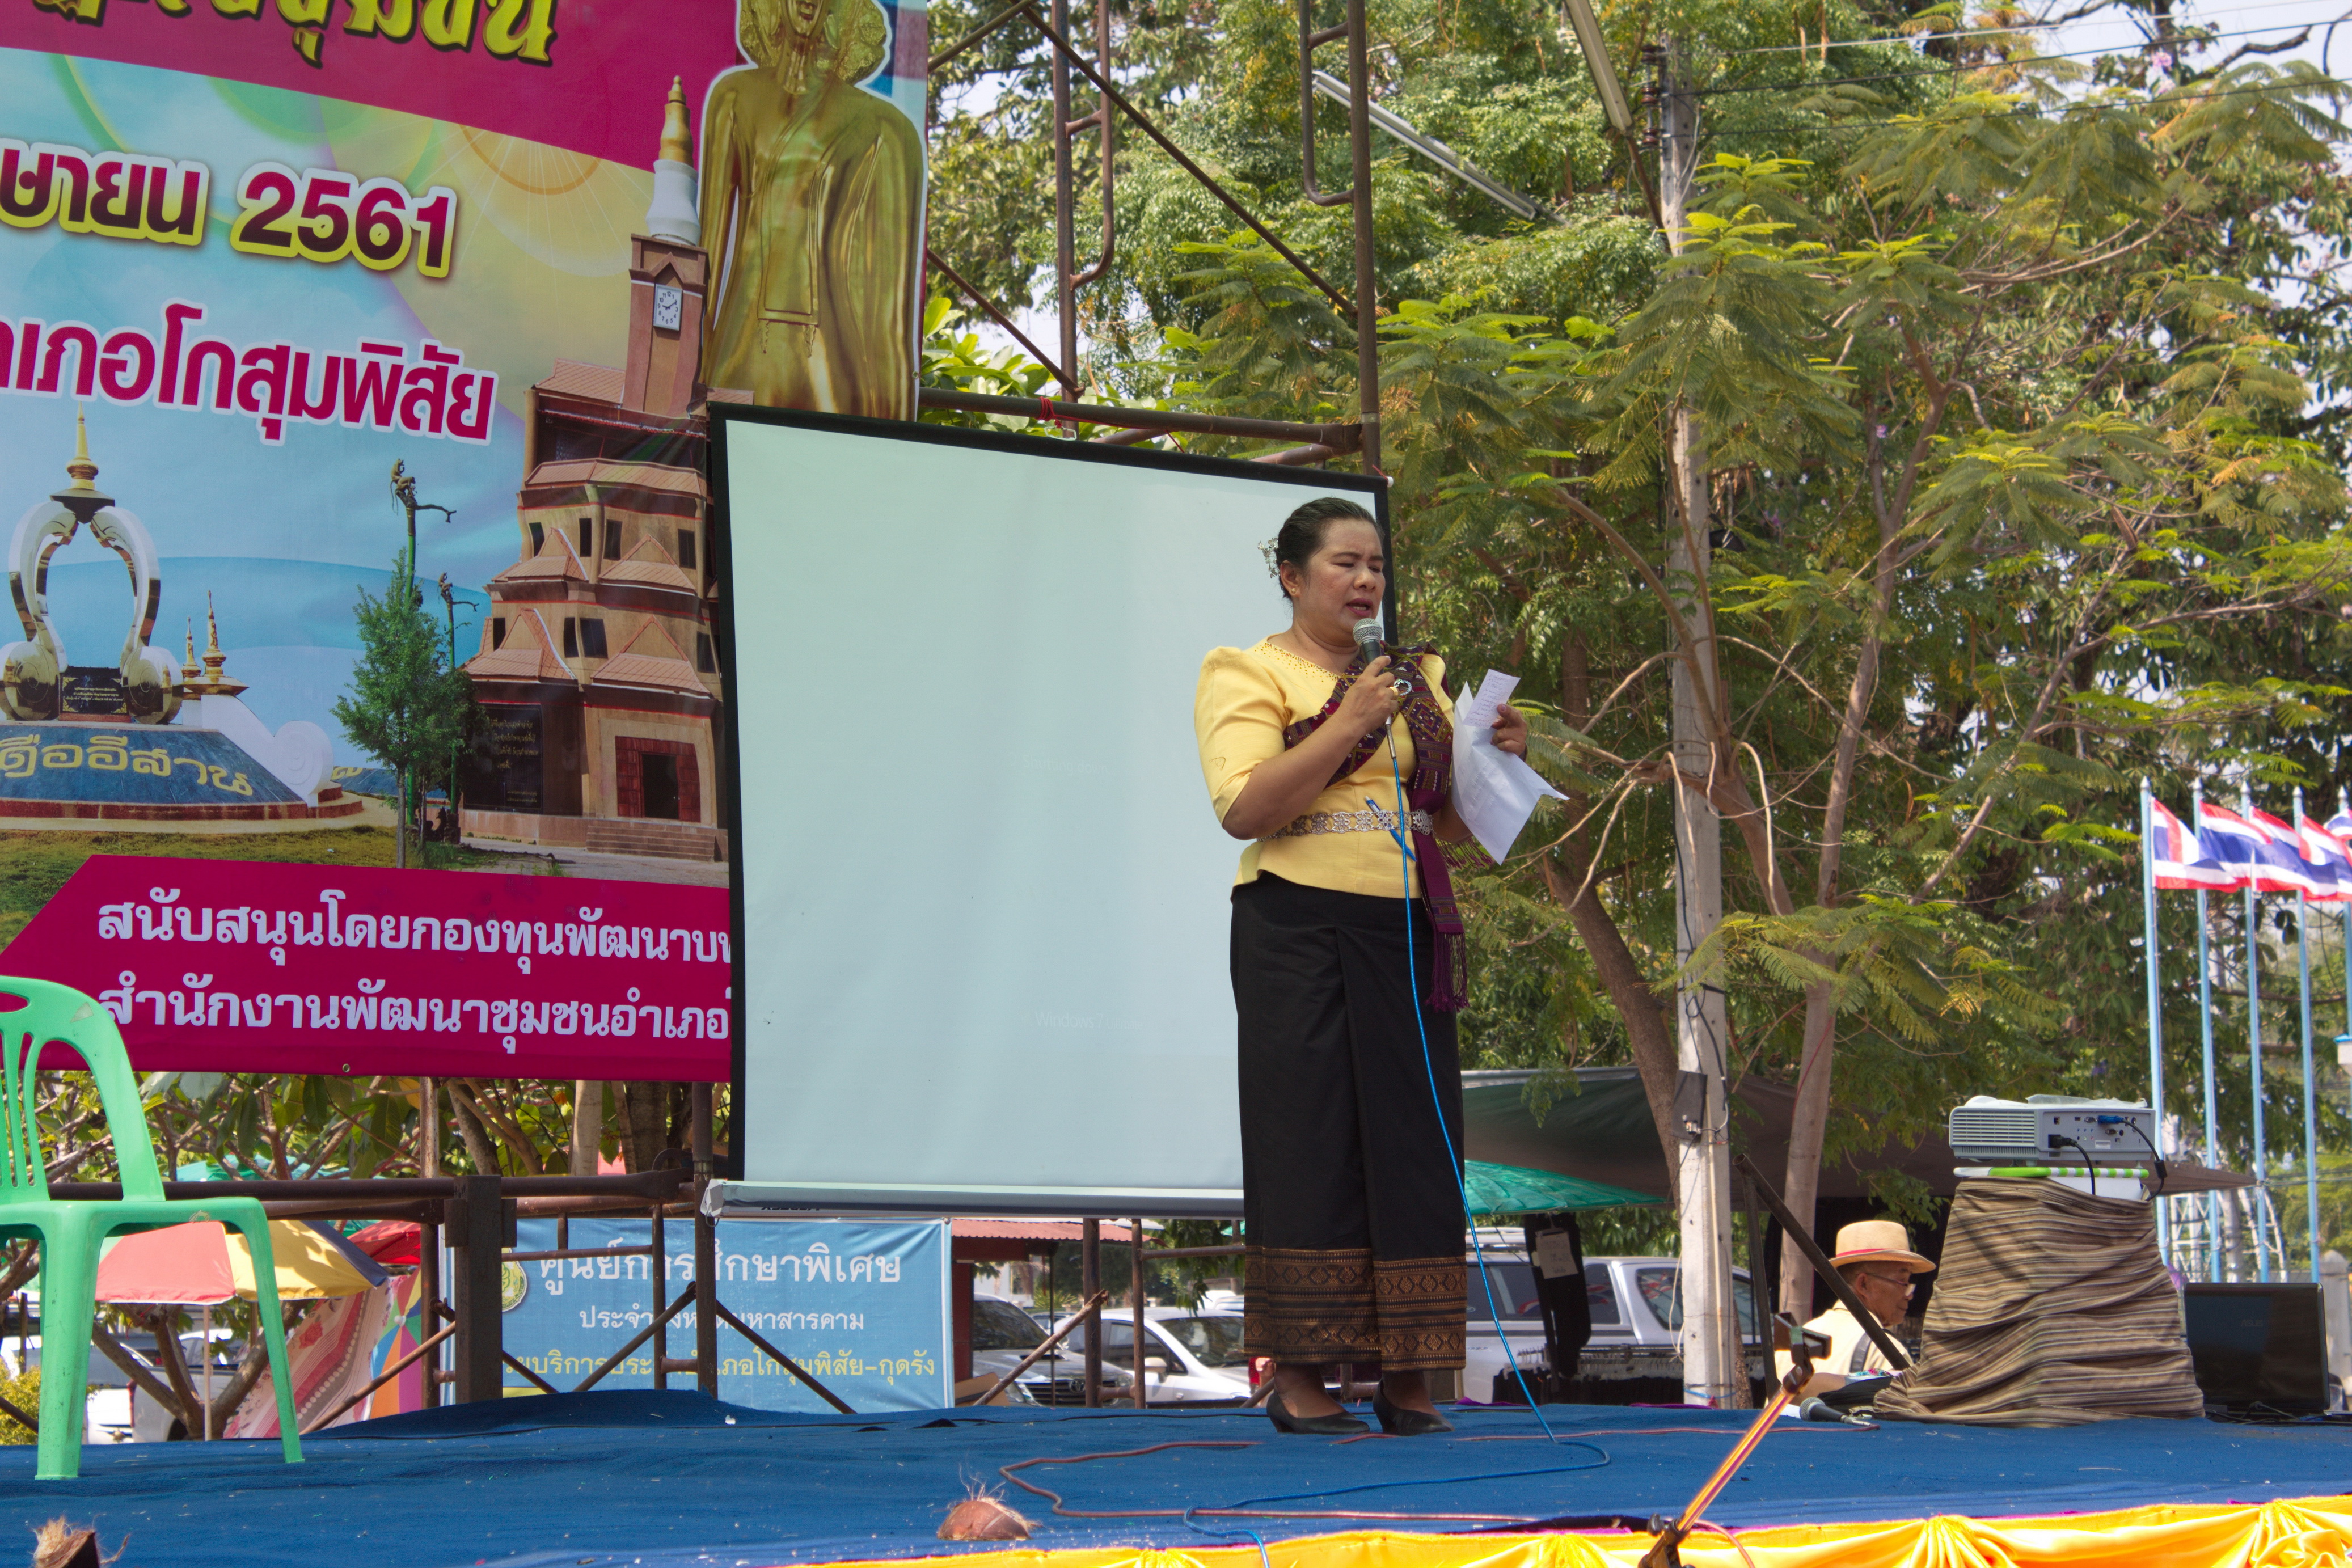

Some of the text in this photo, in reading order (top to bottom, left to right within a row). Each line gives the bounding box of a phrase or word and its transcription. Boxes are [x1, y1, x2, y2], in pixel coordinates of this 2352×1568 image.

[238, 171, 450, 269] 2561
[98, 970, 731, 1054] สำนักงานพัฒนาชุมชนอำเภอ
[1034, 1010, 1095, 1029] Windows
